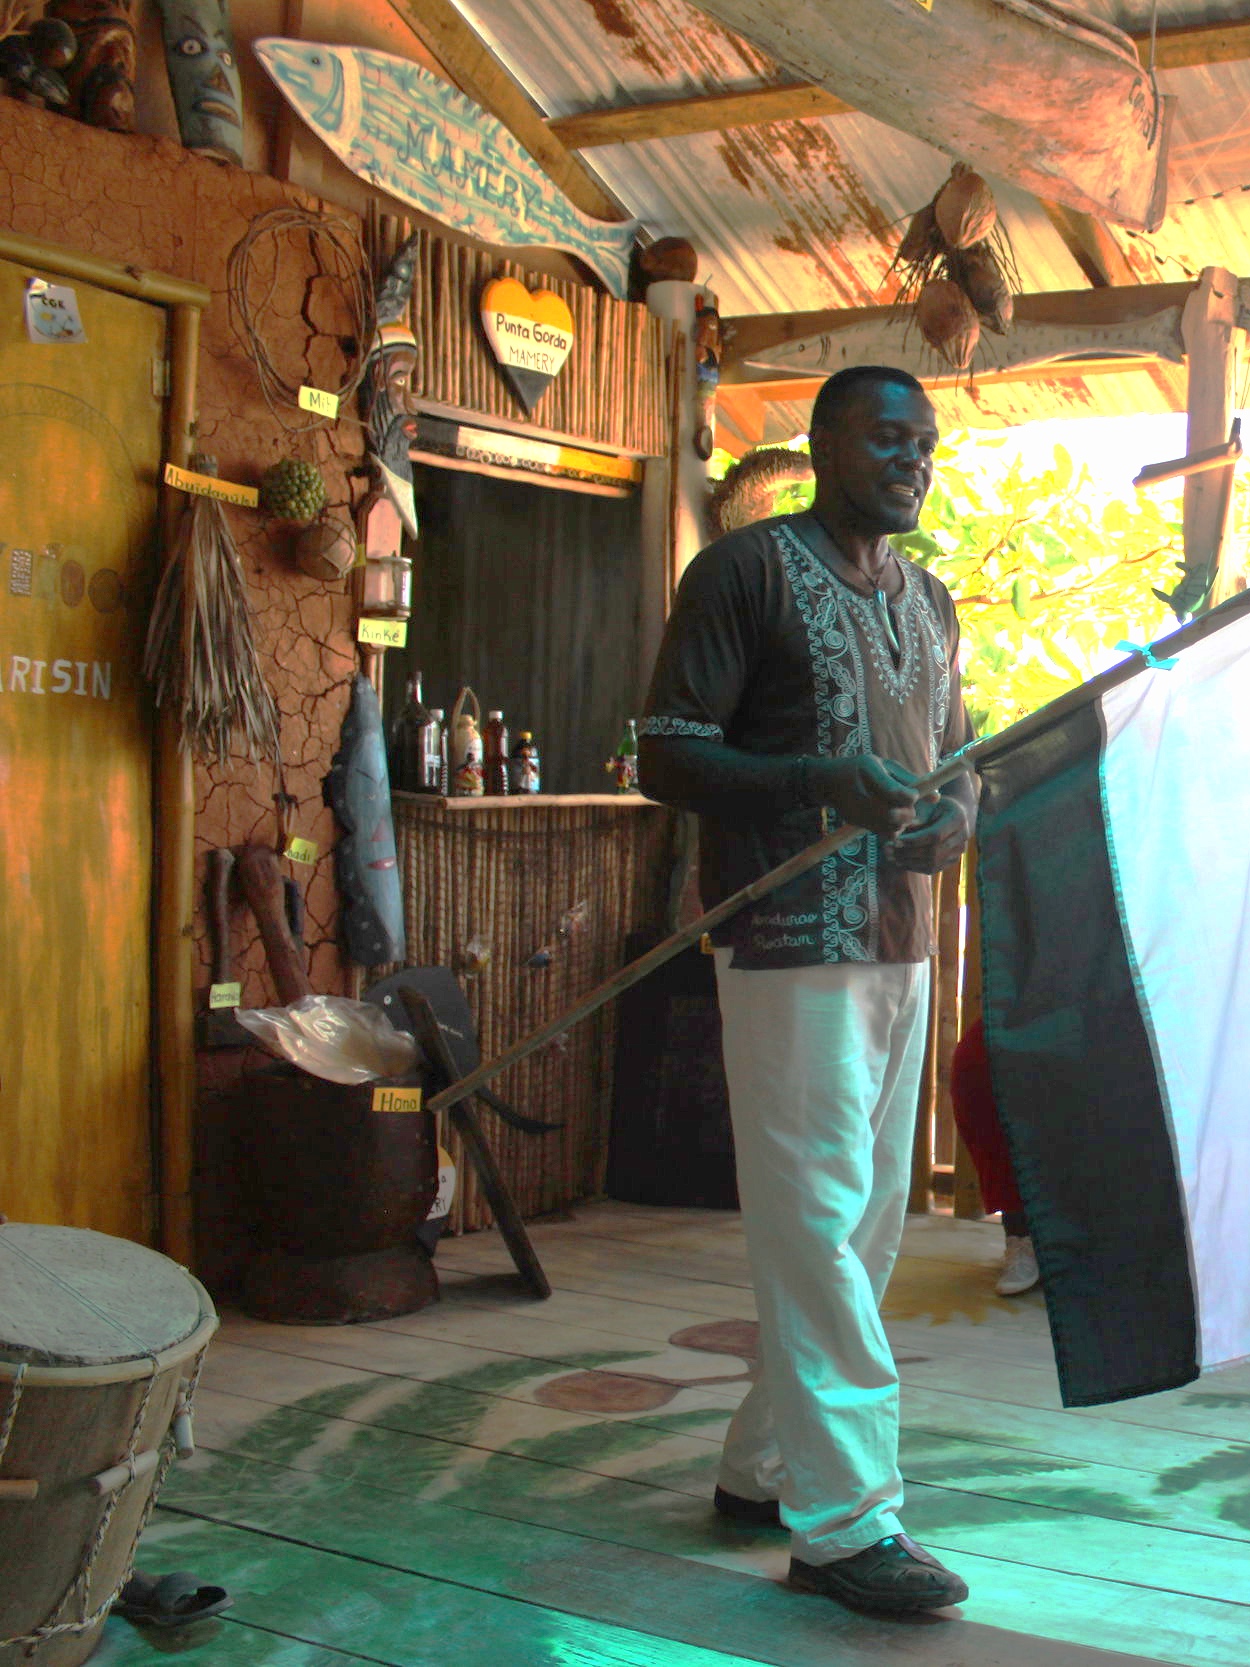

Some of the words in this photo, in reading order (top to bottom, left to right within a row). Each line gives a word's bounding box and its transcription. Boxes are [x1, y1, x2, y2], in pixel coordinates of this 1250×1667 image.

[397, 119, 541, 218] MAMERY
[496, 313, 530, 339] Punta
[533, 323, 567, 351] Gorda
[509, 345, 555, 373] MAMERY
[0, 655, 112, 700] RISIN
